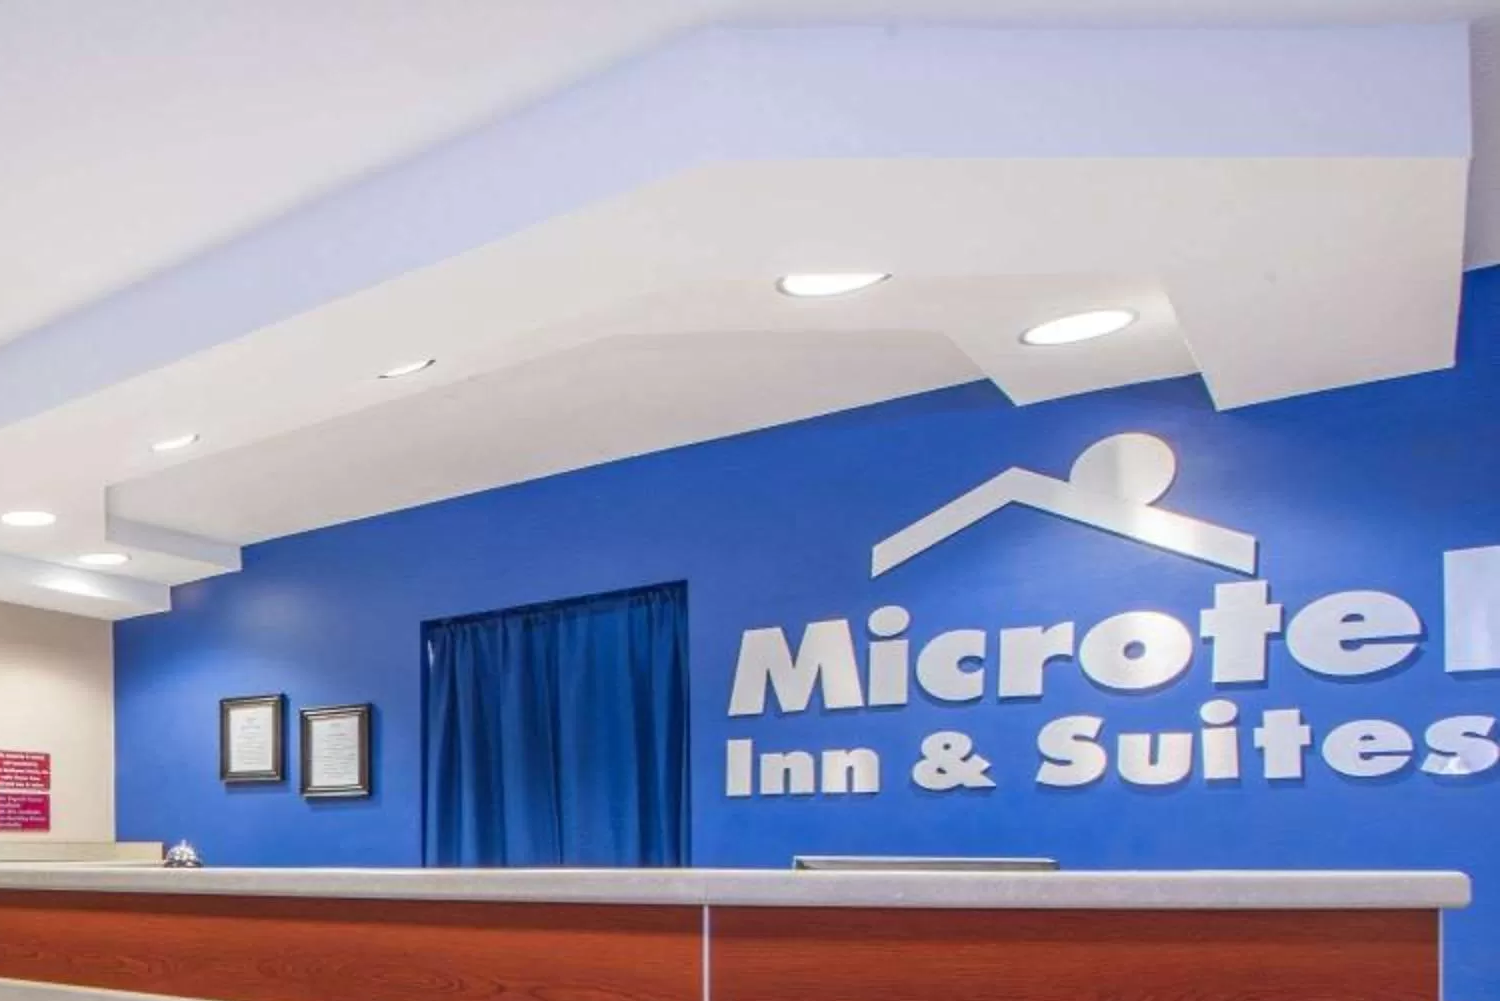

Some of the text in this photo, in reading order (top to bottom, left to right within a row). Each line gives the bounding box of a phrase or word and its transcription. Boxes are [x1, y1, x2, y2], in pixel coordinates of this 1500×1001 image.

[728, 545, 1500, 716] Microtel
[726, 699, 1500, 796] Inn & Suites
